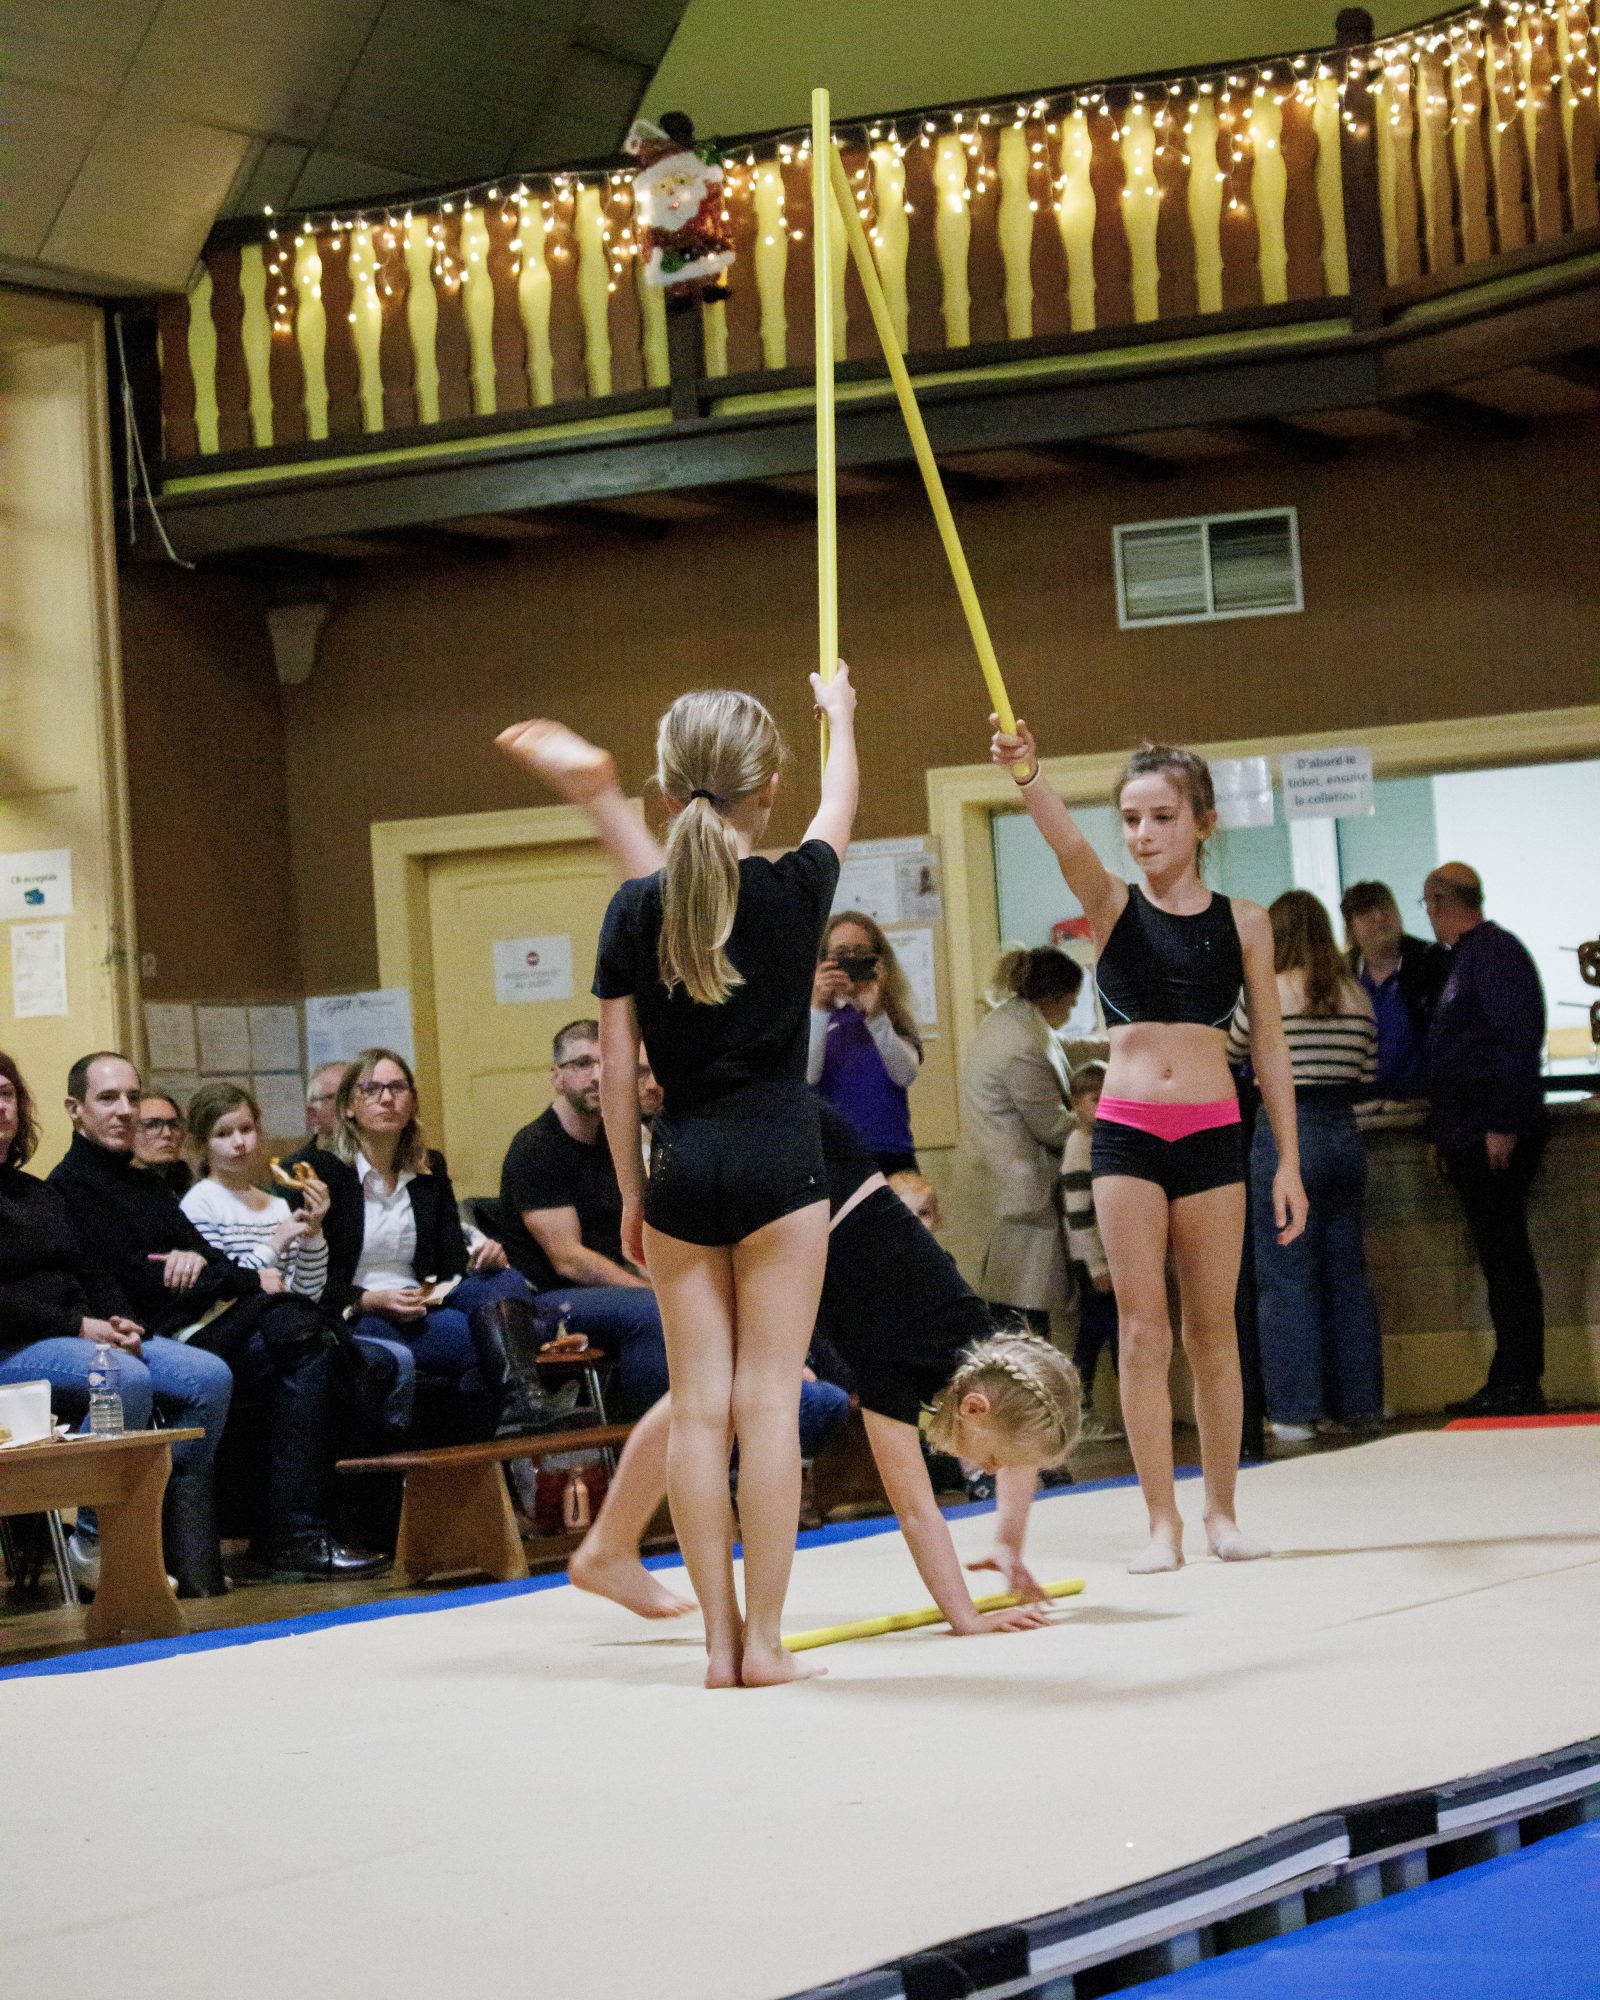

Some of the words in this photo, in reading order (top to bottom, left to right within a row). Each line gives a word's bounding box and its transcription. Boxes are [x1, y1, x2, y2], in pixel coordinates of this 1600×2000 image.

[1297, 755, 1342, 769] D'abord
[1346, 755, 1356, 765] le
[1288, 777, 1322, 788] ticket,
[1327, 772, 1368, 784] ensuite
[1308, 791, 1356, 804] collation
